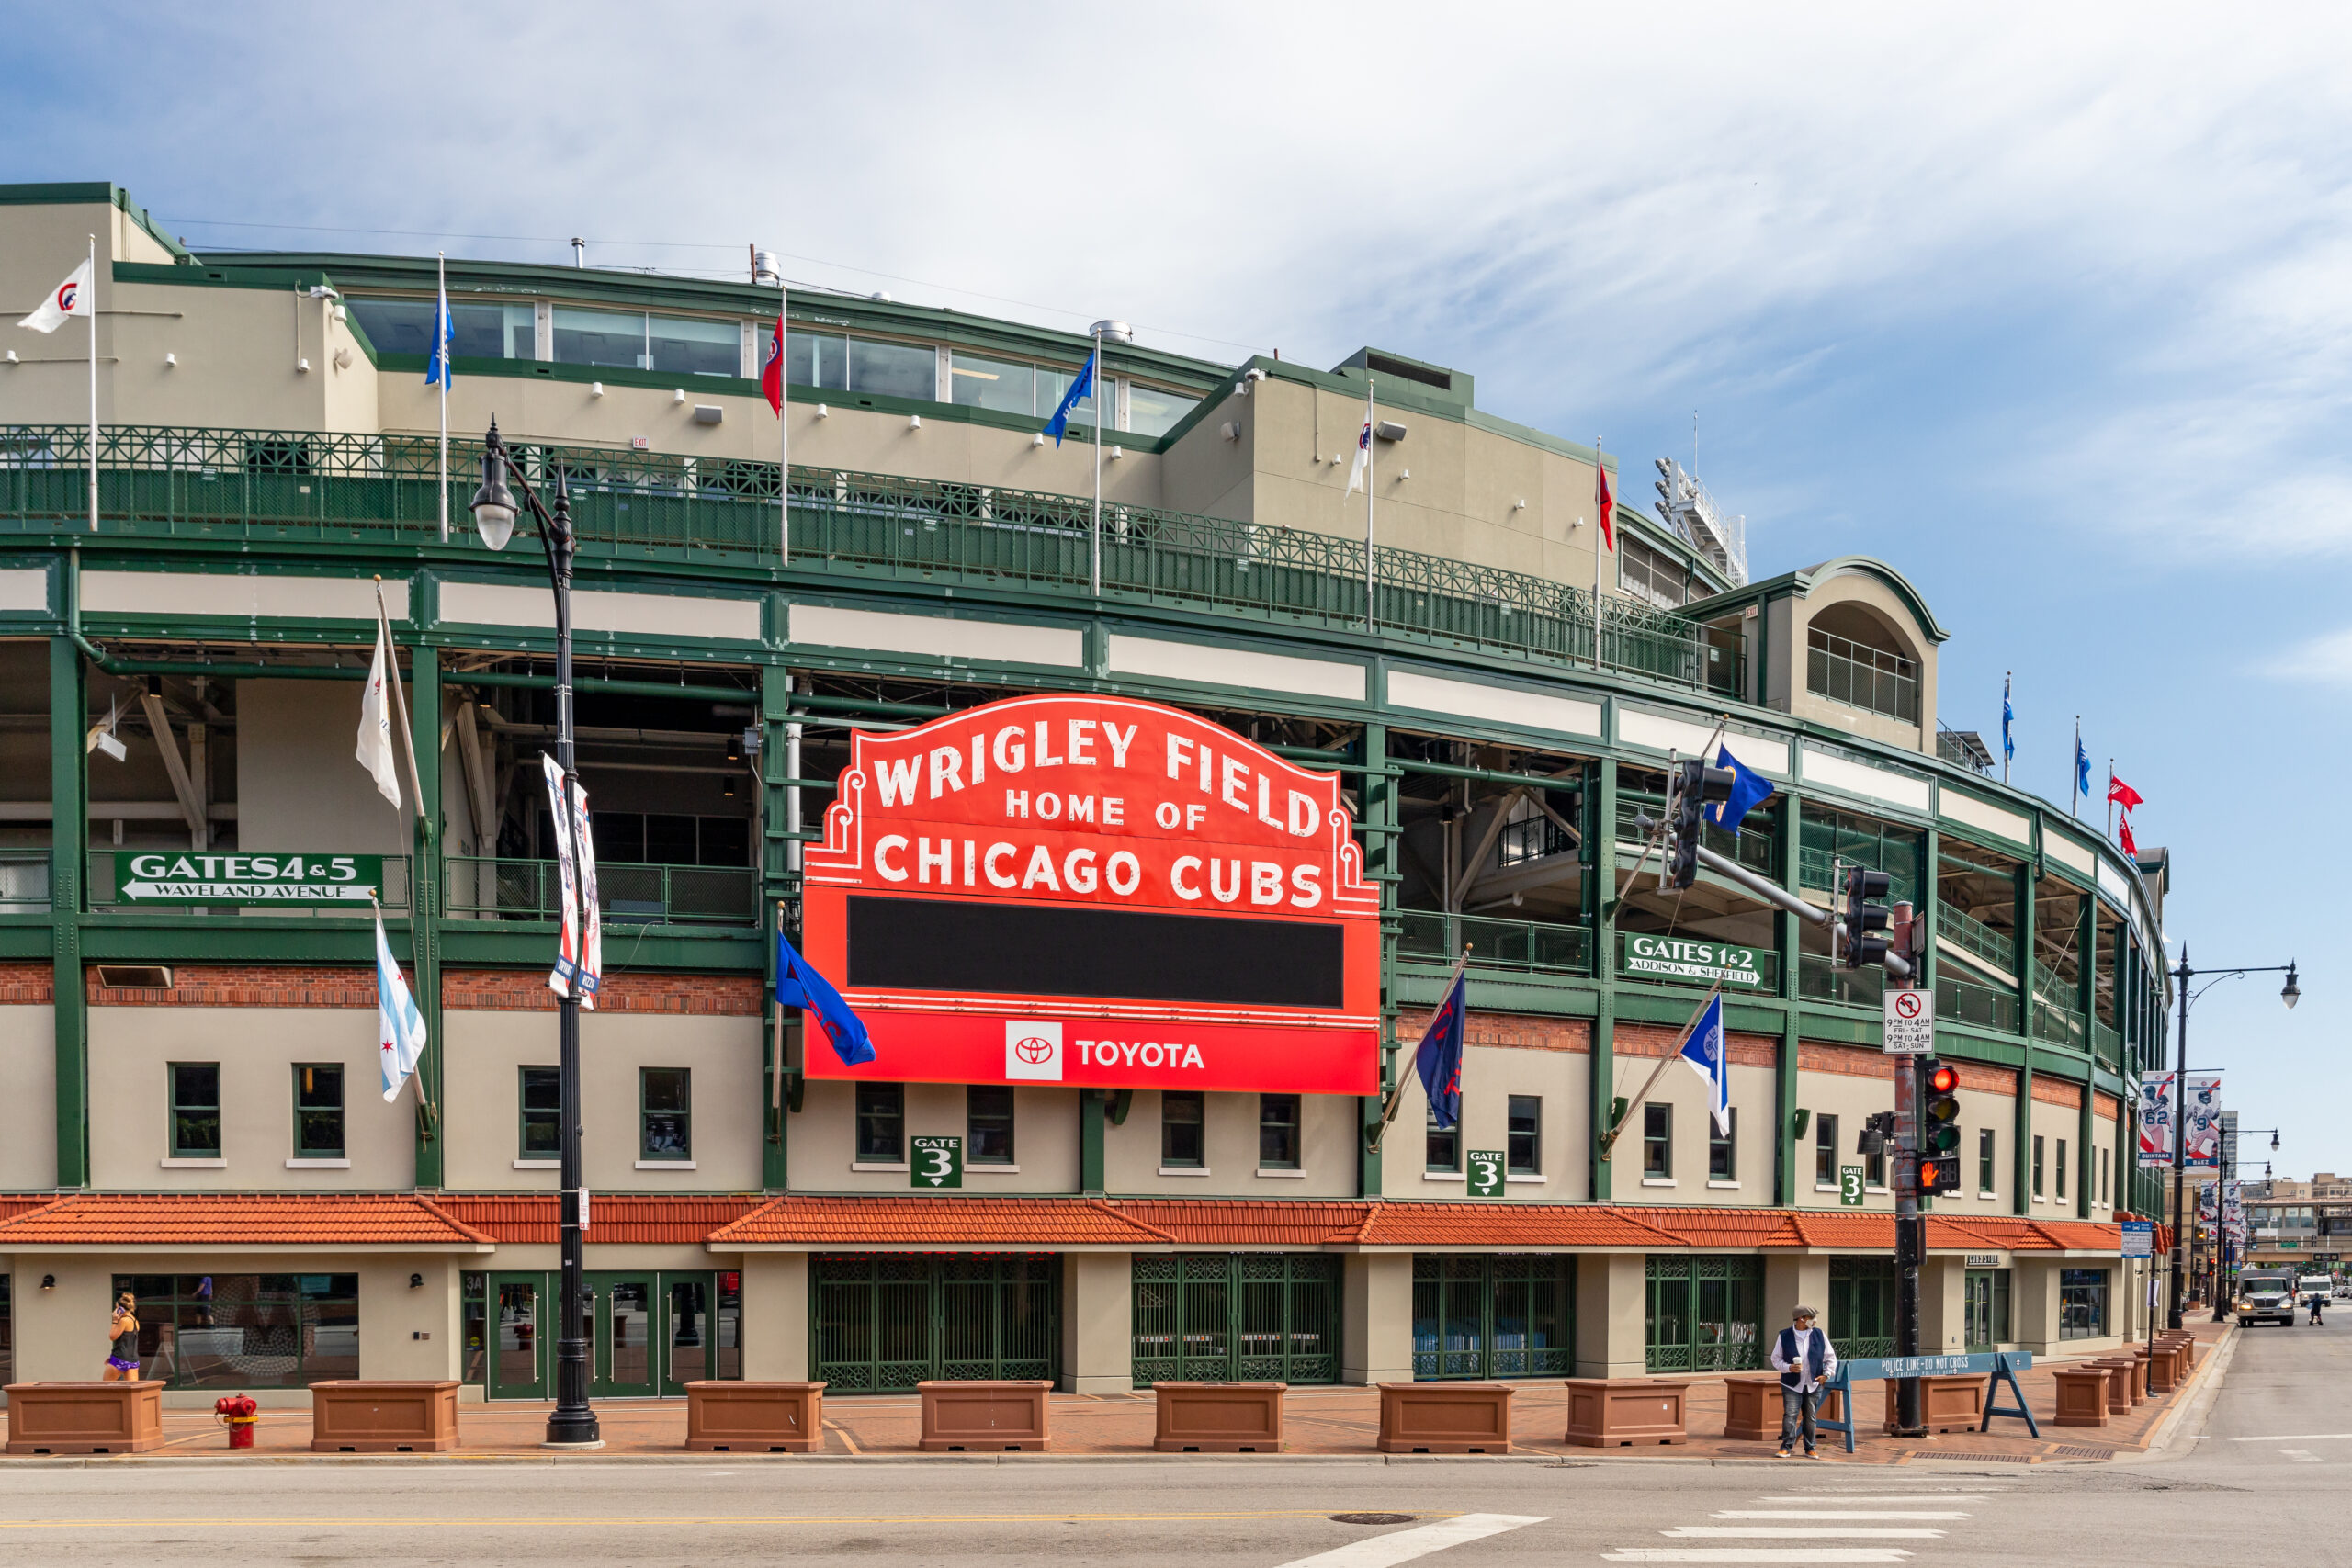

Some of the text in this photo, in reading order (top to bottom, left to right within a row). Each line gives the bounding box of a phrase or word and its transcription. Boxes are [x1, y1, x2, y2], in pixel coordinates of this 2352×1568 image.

[635, 437, 646, 446] EXIT
[874, 719, 1320, 838] WRIGLEY FIELD
[1006, 789, 1206, 831] HOME OF
[874, 834, 1322, 908] CHICAGO CUBS
[154, 884, 347, 898] WAVELAND AVENUE
[1634, 937, 1712, 963] GATES
[1634, 960, 1684, 973] ADDISON
[1689, 966, 1696, 975] &
[1075, 1040, 1204, 1069] TOYOTA
[2145, 1111, 2168, 1125] 62
[2197, 1117, 2207, 1130] 9
[914, 1138, 959, 1148] GATE
[921, 1148, 952, 1176] 3
[1470, 1152, 1503, 1161] GATE
[1474, 1161, 1498, 1186] 3
[1845, 1175, 1860, 1197] 3
[467, 1276, 482, 1290] 3A
[1882, 1359, 1903, 1372] POLICE
[1936, 1357, 1948, 1369] NOT
[1949, 1356, 1968, 1368] CROSS
